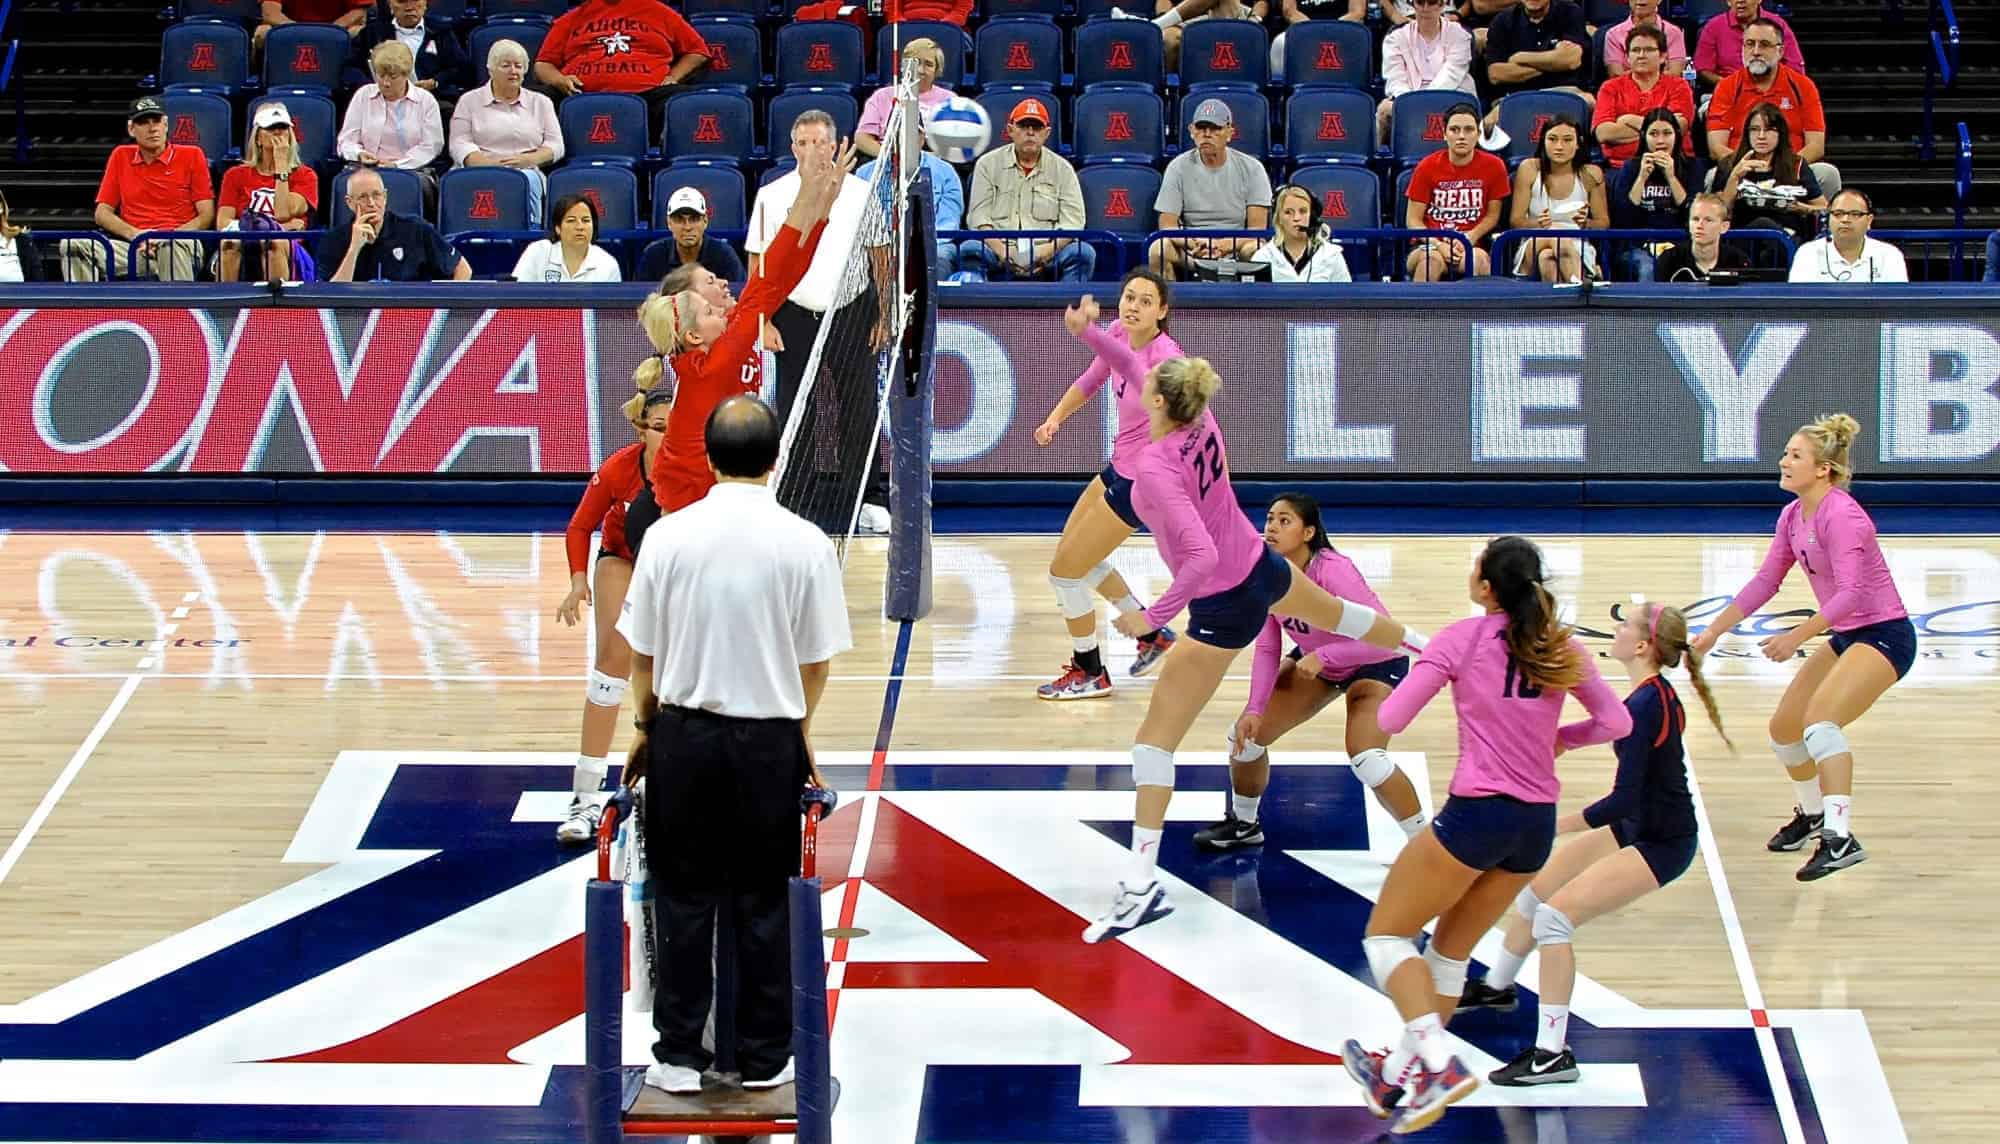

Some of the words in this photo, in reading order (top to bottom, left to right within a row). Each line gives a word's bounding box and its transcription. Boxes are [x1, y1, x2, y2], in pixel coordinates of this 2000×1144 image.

[189, 43, 217, 71] A
[292, 45, 320, 71] A
[807, 43, 835, 71] A
[1007, 42, 1034, 70] A
[1108, 42, 1134, 70] A
[1211, 42, 1239, 70] A
[1316, 42, 1344, 70] A
[171, 114, 200, 143] A
[589, 114, 616, 143] A
[694, 114, 722, 143] A
[1104, 112, 1133, 141] A
[1317, 112, 1346, 141] A
[469, 190, 499, 219] A
[1104, 188, 1134, 219] A
[1322, 190, 1350, 219] A
[1642, 185, 1673, 199] RIZO
[1193, 432, 1224, 501] 22
